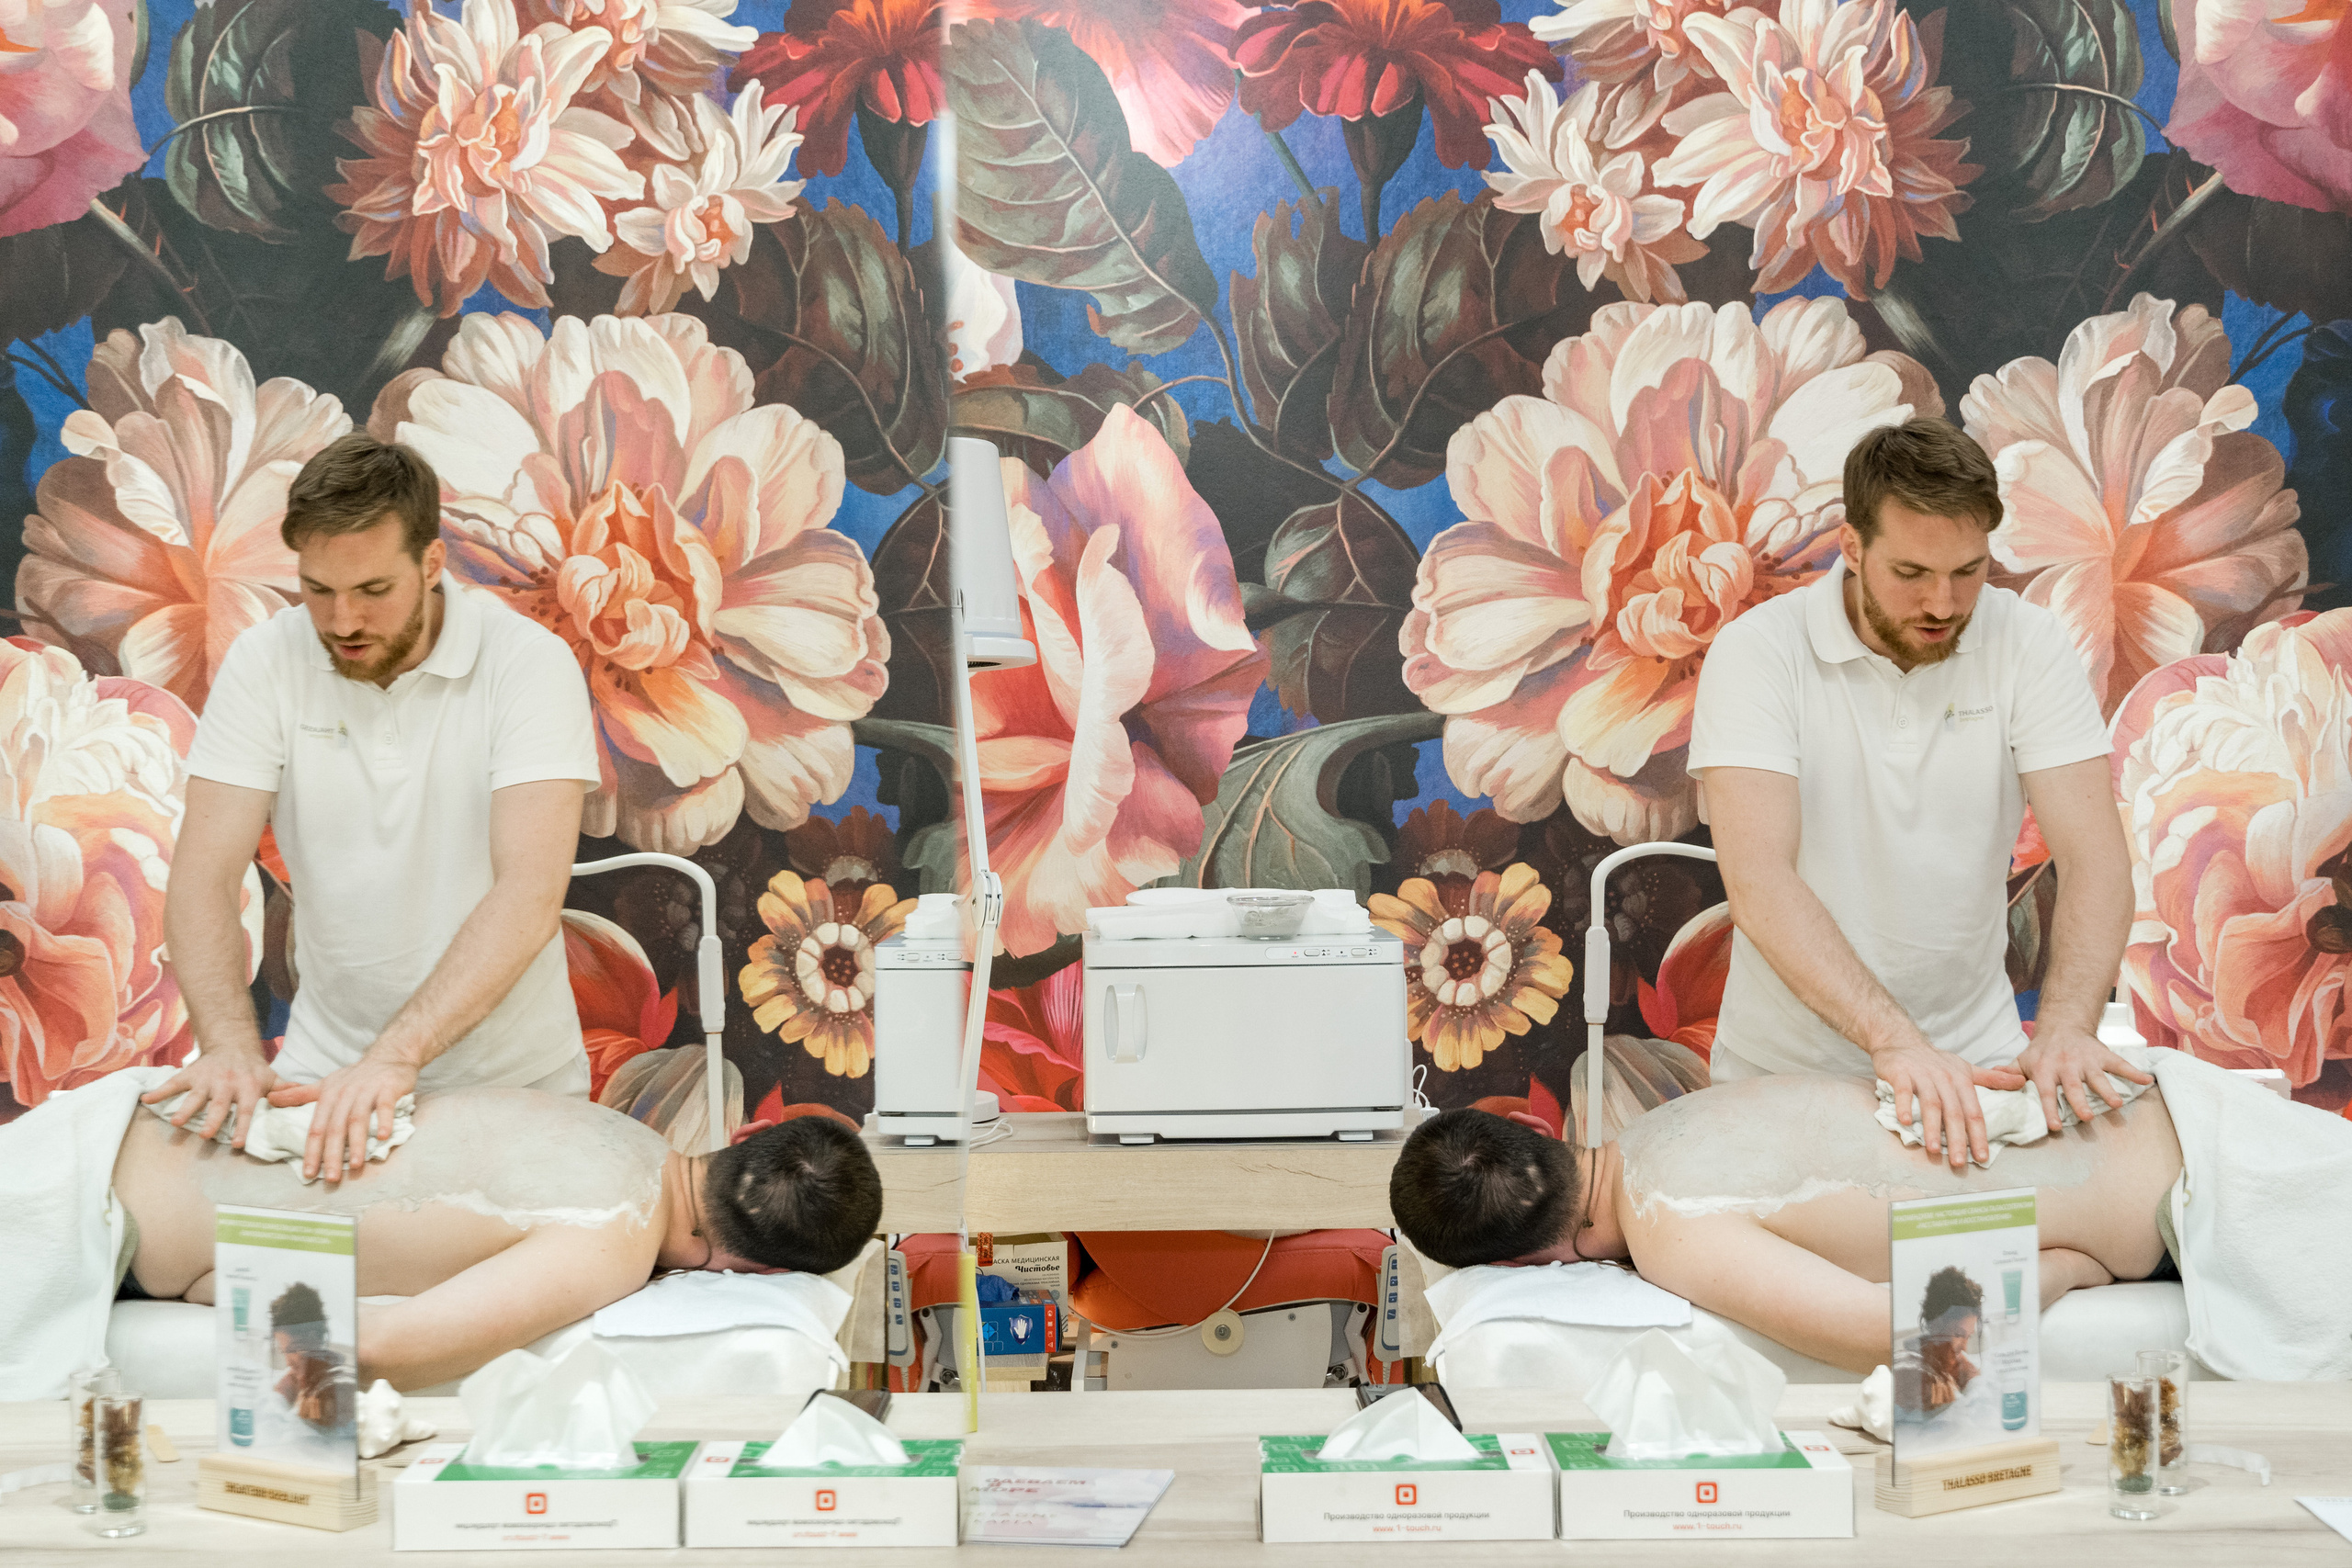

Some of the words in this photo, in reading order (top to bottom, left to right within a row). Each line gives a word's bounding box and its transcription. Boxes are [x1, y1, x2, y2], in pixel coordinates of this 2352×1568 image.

[1958, 705, 1994, 716] THALASSO
[1011, 1256, 1060, 1265] МЕДИЦИНСКАЯ
[1014, 1264, 1060, 1273] Чистовье
[1941, 1472, 1985, 1491] THALASSO
[1987, 1464, 2032, 1483] BRETAGNE
[1323, 1512, 1385, 1521] Производство
[1385, 1511, 1442, 1520] одноразовой
[1443, 1511, 1490, 1520] продукции
[1623, 1510, 1685, 1518] Производство
[1686, 1509, 1743, 1517] одноразовой
[1744, 1509, 1791, 1518] продукции
[1373, 1524, 1442, 1532] www.1-touch.ru
[1673, 1522, 1743, 1530] www.1-touch.ru
